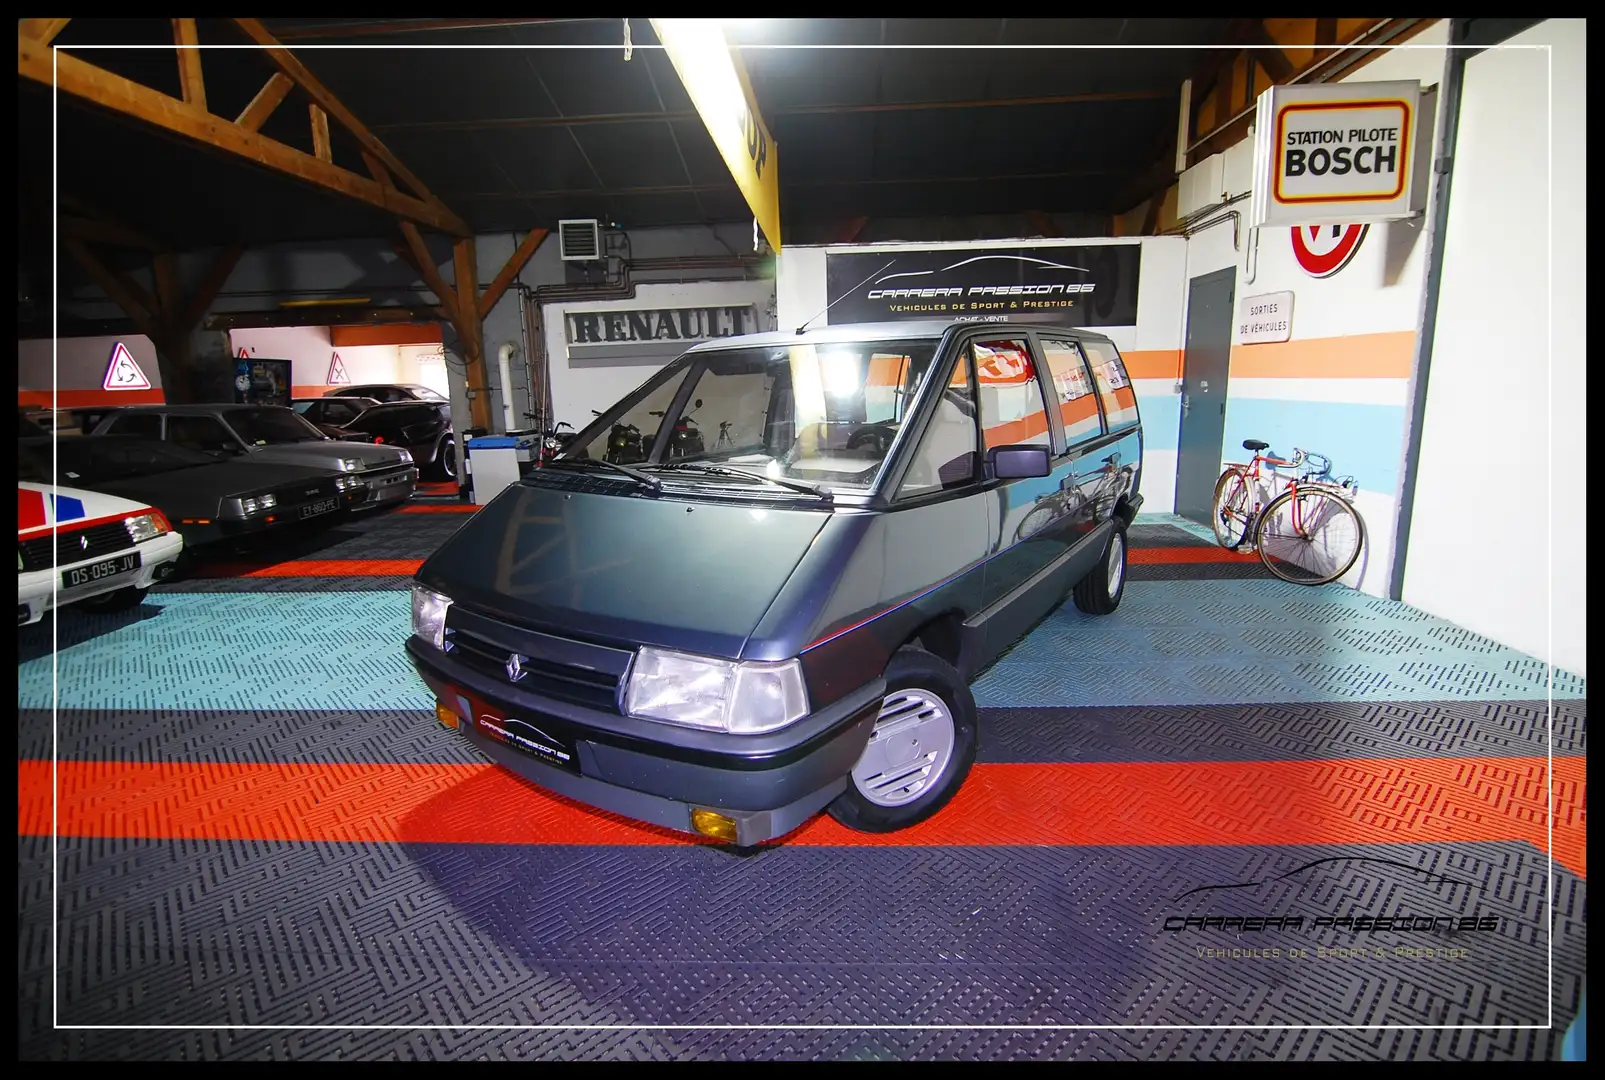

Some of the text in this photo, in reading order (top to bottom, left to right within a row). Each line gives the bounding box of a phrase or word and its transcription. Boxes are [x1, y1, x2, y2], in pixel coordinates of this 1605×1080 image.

[1287, 128, 1398, 145] STATION PILOTE
[1285, 145, 1397, 177] BOSCH
[867, 286, 963, 299] CARRERA
[967, 284, 1064, 297] PASSION
[889, 304, 947, 312] VEHICULES
[970, 301, 1005, 310] SPORT
[1023, 300, 1074, 308] PRESTIGE
[1250, 303, 1278, 316] SORTIES
[574, 306, 750, 343] RENAULT
[1240, 324, 1248, 334] DE
